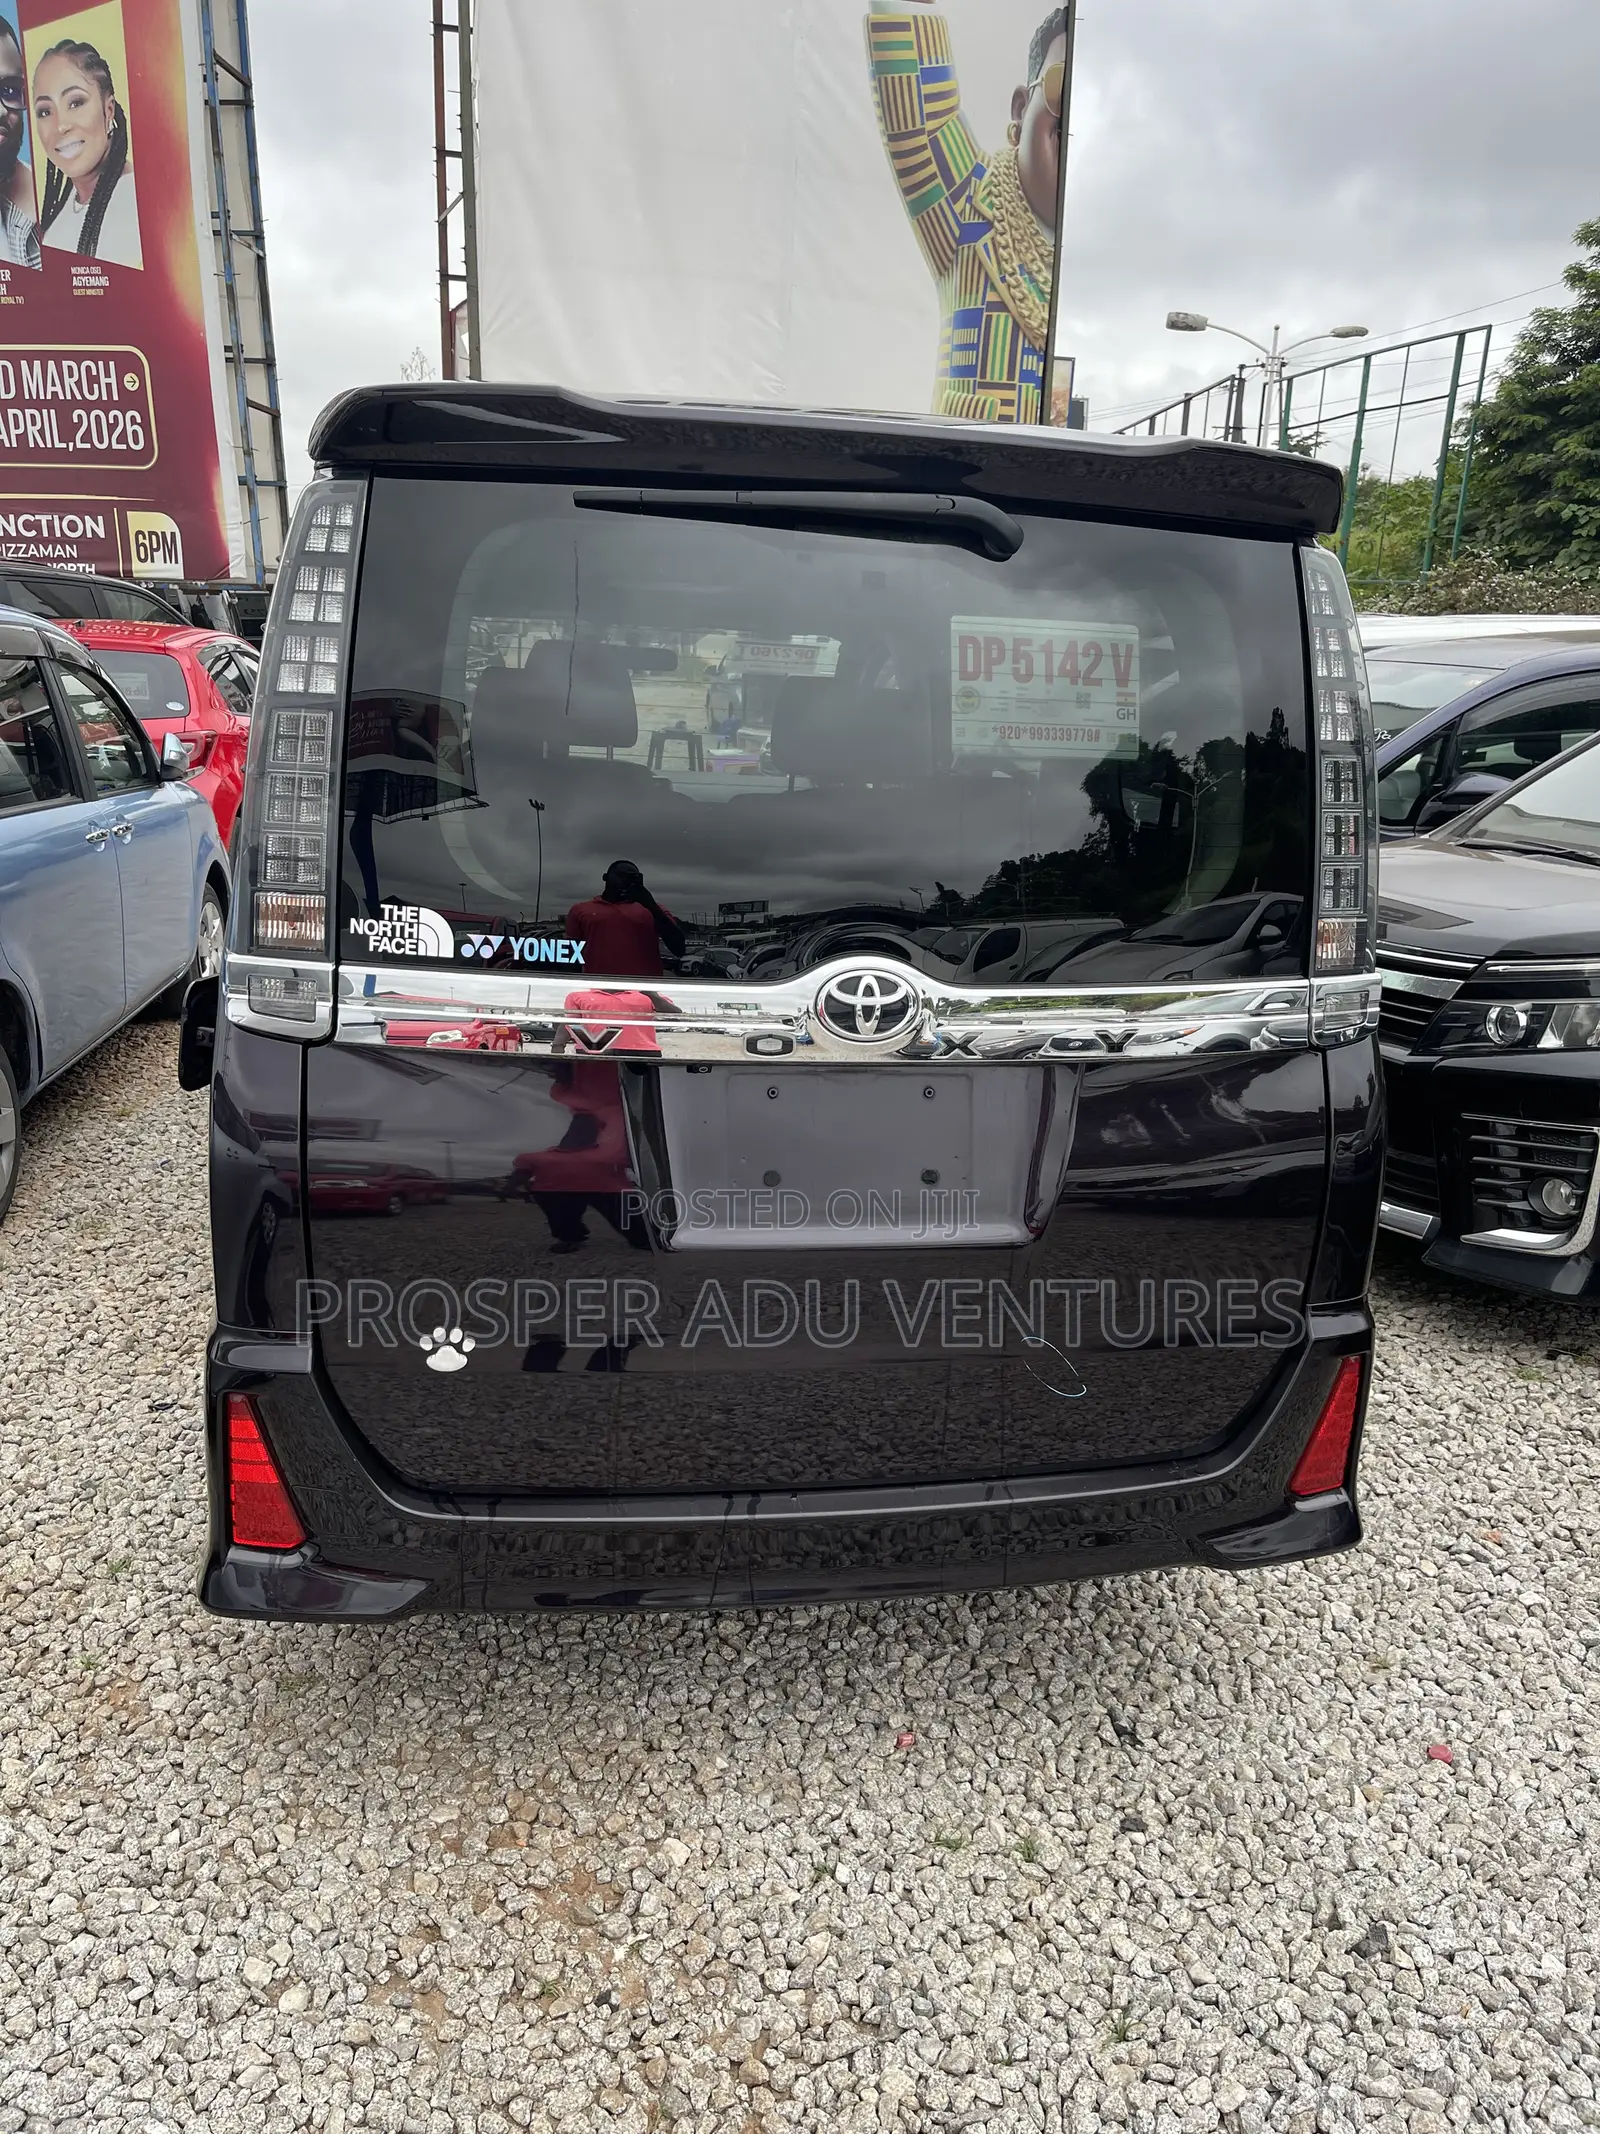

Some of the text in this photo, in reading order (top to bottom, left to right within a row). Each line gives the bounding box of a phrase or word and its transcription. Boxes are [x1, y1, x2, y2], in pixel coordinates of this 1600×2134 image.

[72, 276, 109, 287] AGYEMANG
[21, 360, 119, 401] MARCH
[134, 529, 179, 565] 6PM
[958, 635, 1134, 688] DP 5142 V
[1116, 707, 1137, 721] GH
[380, 903, 419, 923] THE
[350, 917, 418, 939] NORTH
[369, 936, 418, 956] FACE
[509, 936, 587, 964] YONEX
